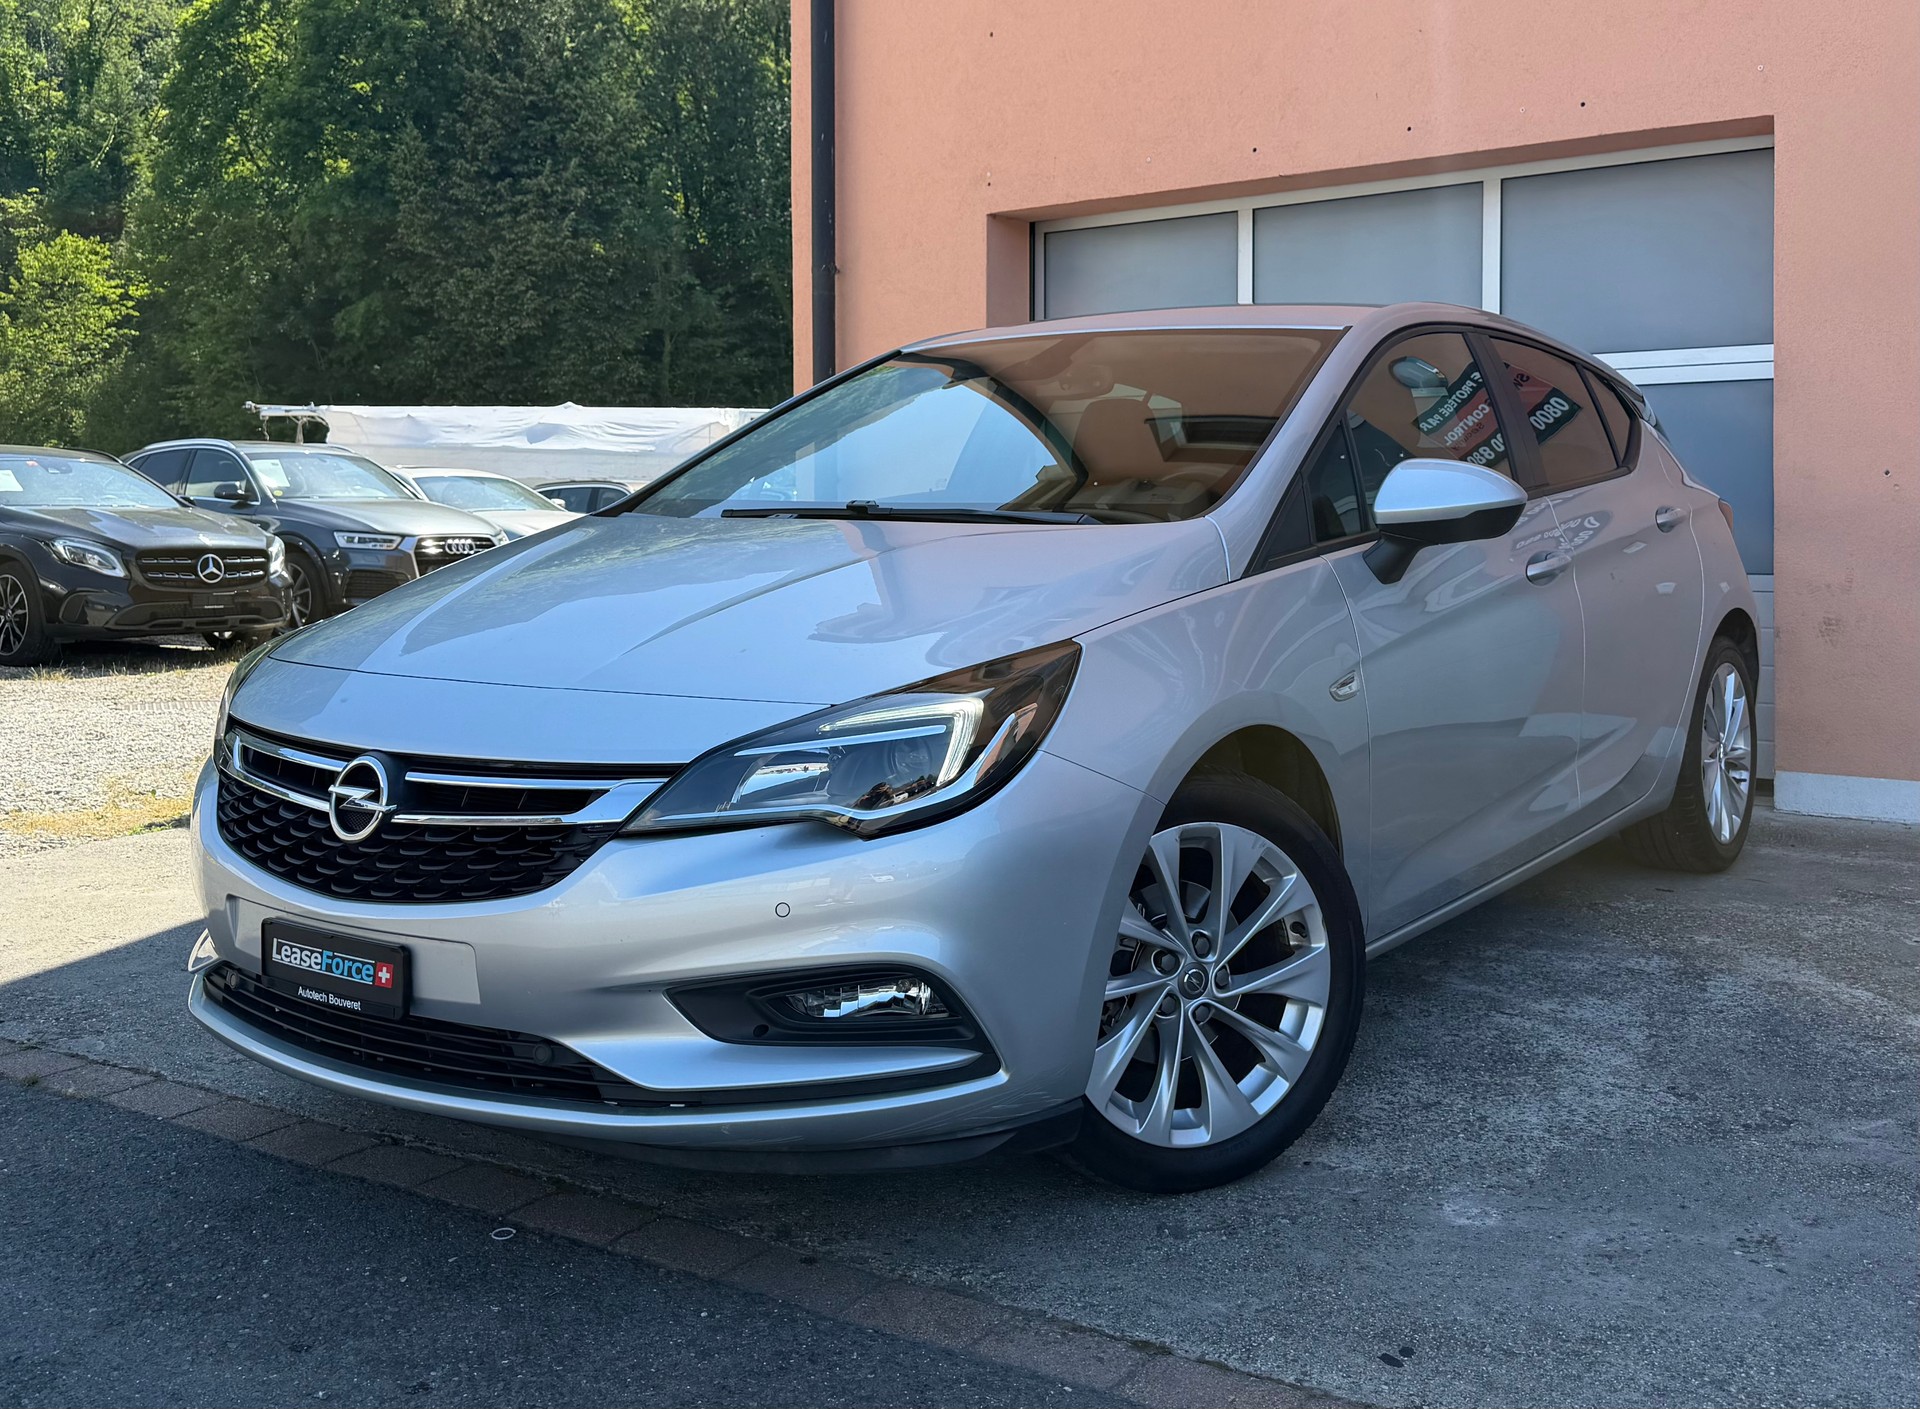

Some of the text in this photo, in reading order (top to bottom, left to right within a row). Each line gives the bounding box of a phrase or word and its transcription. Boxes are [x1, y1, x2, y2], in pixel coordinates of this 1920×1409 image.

[271, 937, 375, 983] LeaseForce
[297, 985, 362, 1011] Autotech Bouveret
